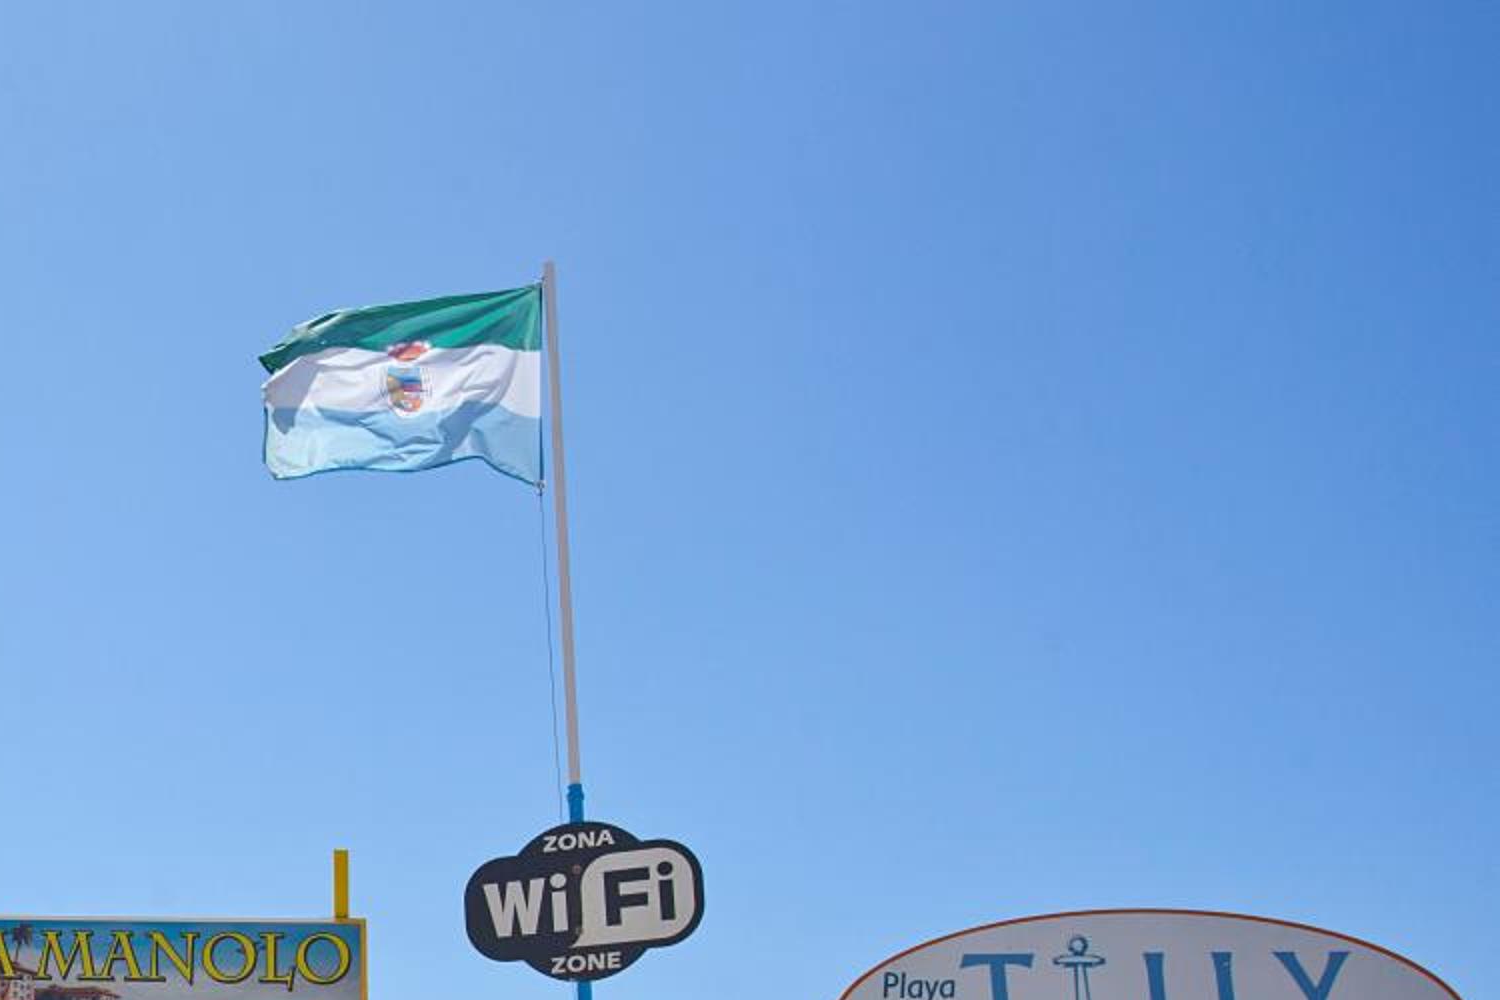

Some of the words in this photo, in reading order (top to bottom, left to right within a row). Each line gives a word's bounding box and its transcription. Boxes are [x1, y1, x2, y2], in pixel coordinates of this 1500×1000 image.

[542, 828, 615, 853] ZONA
[483, 861, 677, 938] WiFi
[38, 931, 351, 991] MANOLO
[551, 951, 622, 975] ZONE
